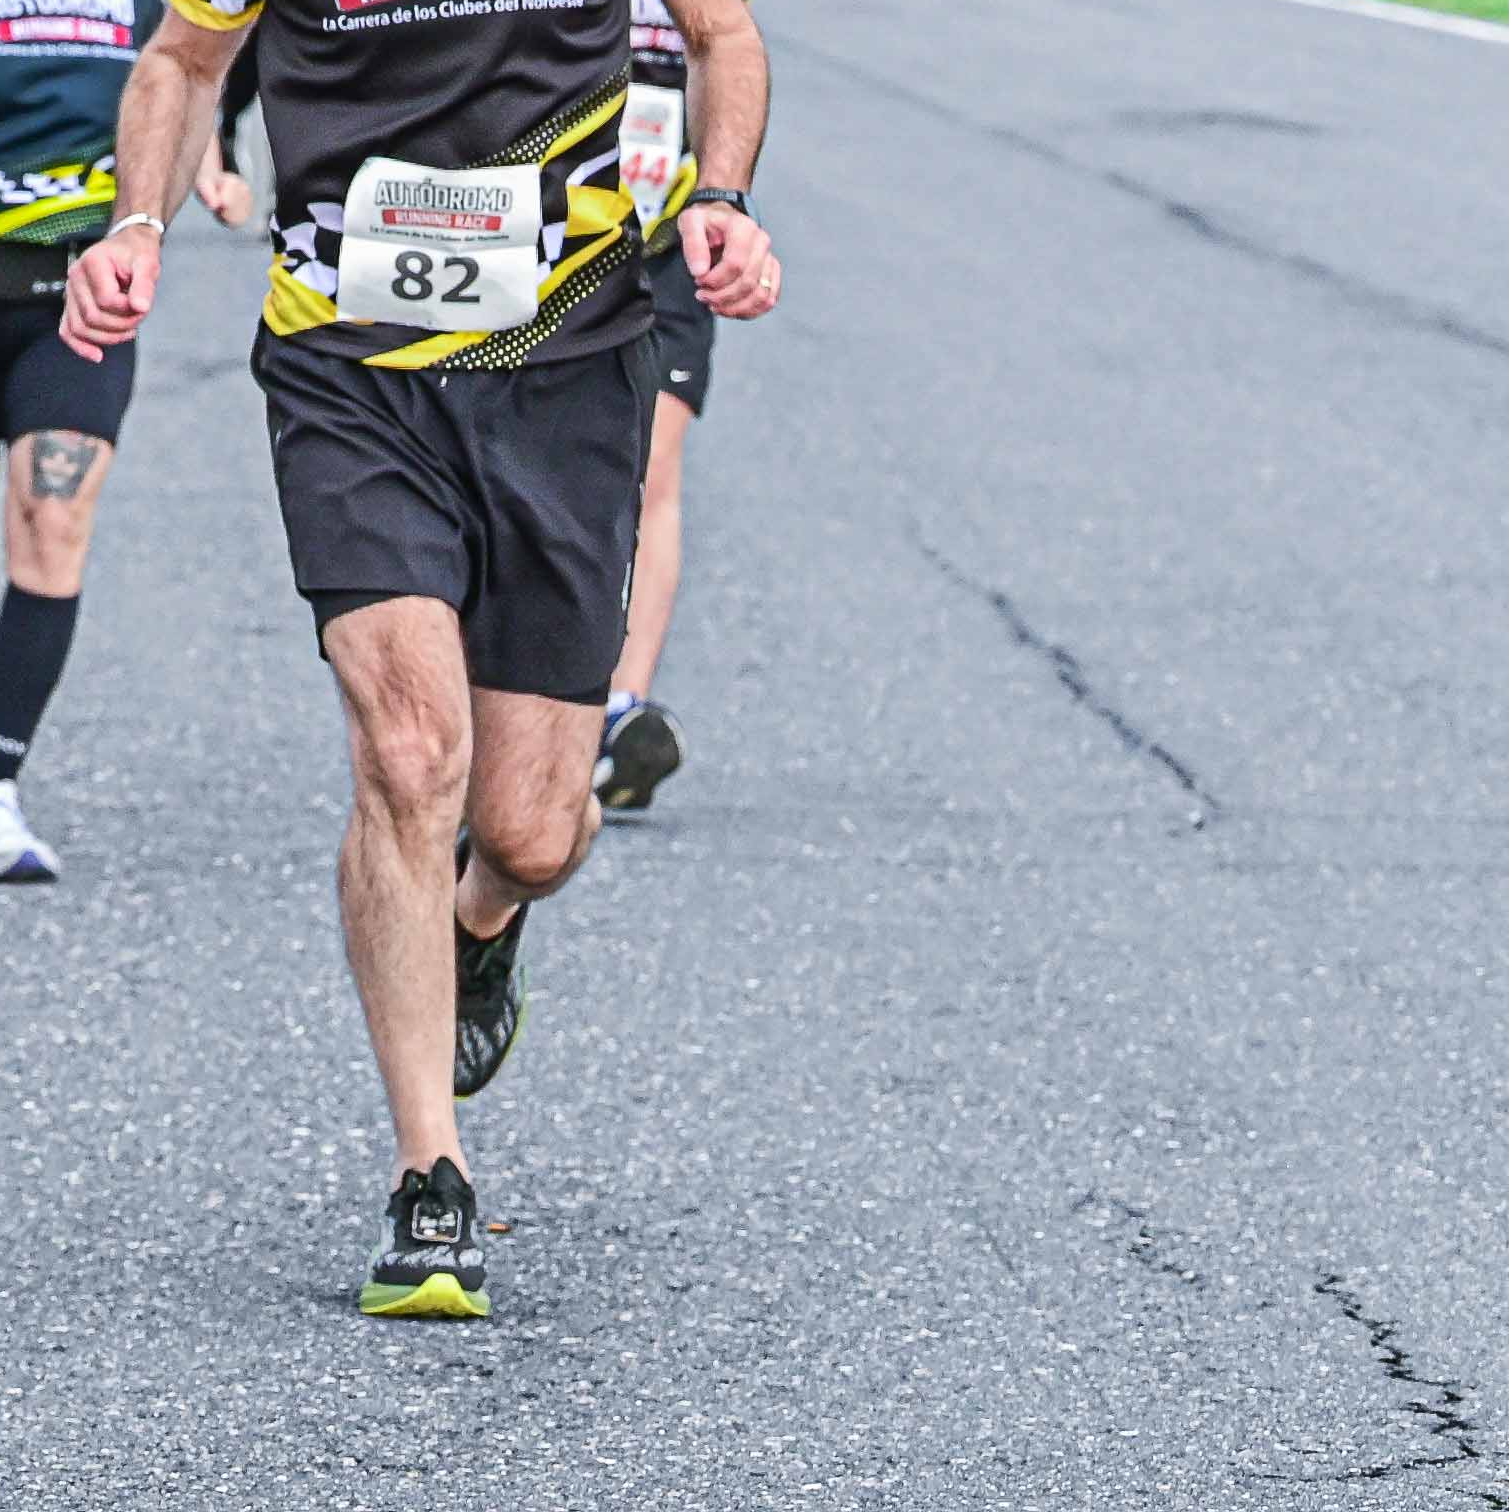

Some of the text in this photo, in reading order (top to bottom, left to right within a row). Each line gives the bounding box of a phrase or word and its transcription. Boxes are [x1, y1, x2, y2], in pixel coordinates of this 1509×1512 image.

[323, 16, 337, 32] La
[338, 13, 391, 31] Carrera
[392, 6, 413, 24] de
[414, 3, 438, 21] los
[374, 177, 514, 213] AUTÓDROMO
[391, 250, 481, 304] 82
